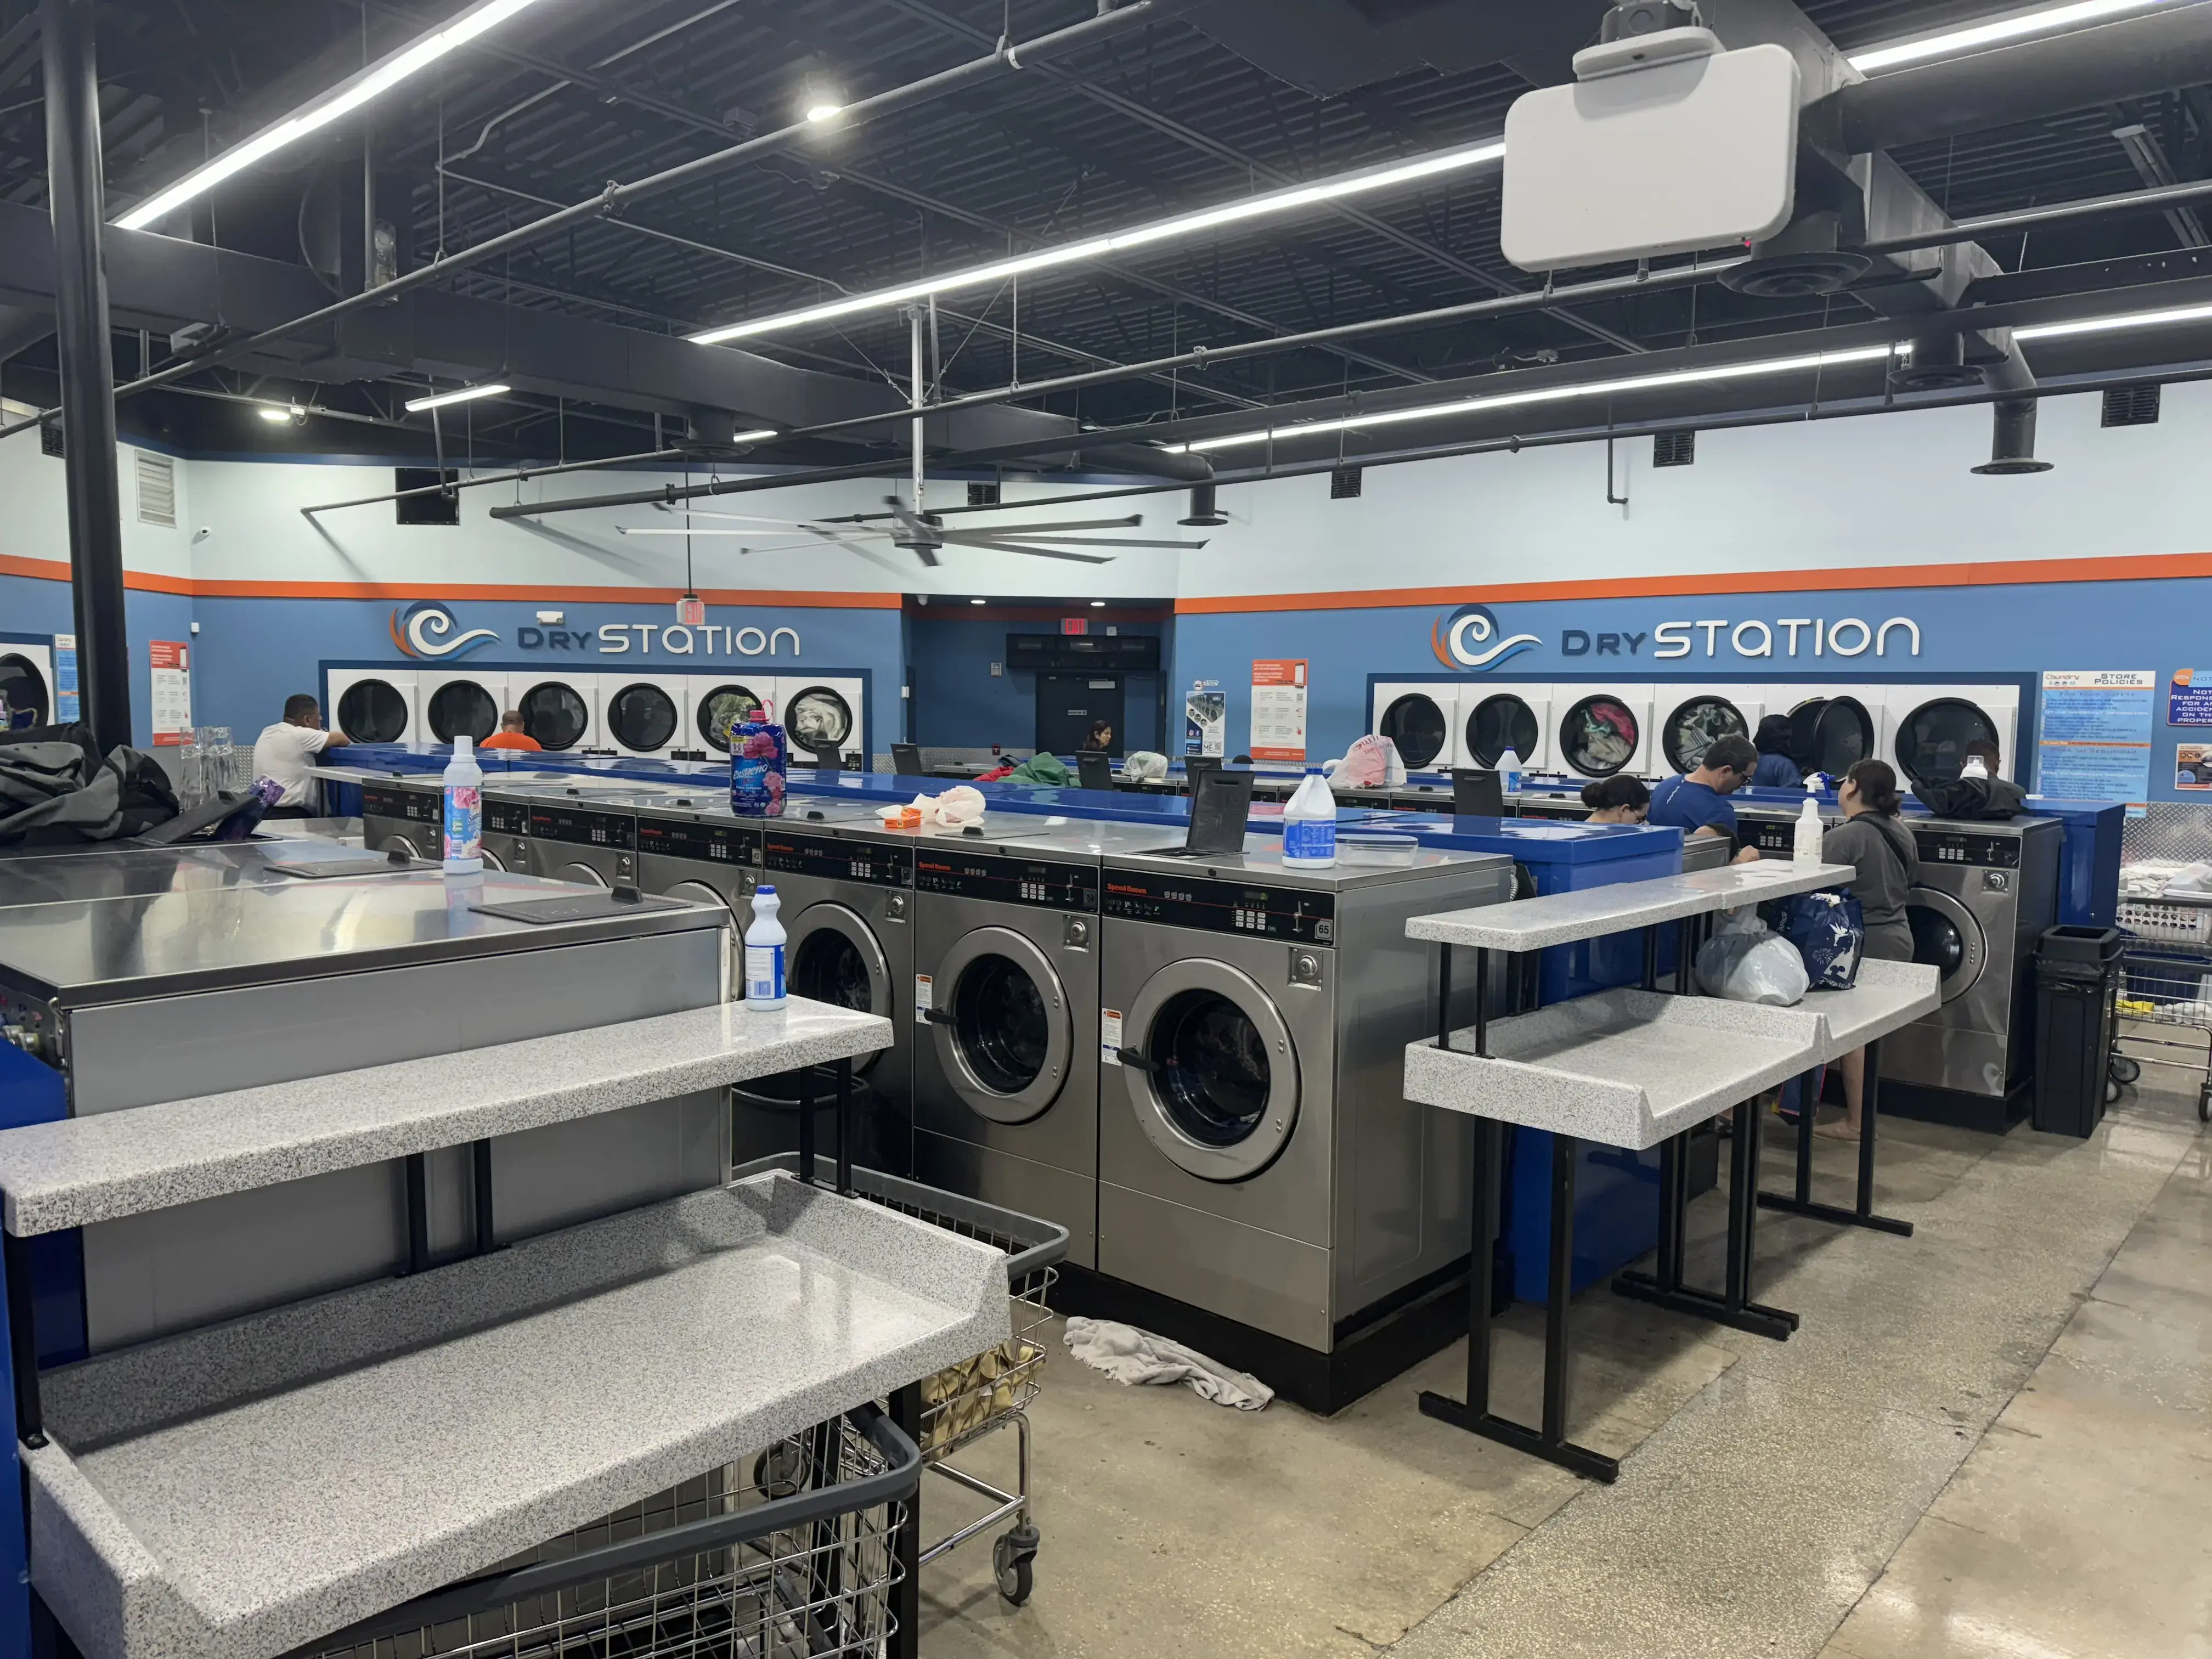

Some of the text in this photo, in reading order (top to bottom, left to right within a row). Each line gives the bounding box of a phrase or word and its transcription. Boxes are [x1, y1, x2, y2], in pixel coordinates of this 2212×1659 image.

[685, 602, 702, 624] EXIT
[1065, 618, 1085, 634] EXIT
[518, 624, 800, 656] DRY STATION
[1562, 617, 1920, 658] DRY STATION
[1107, 883, 1147, 894] Speed Queen
[1318, 924, 1329, 934] 65
